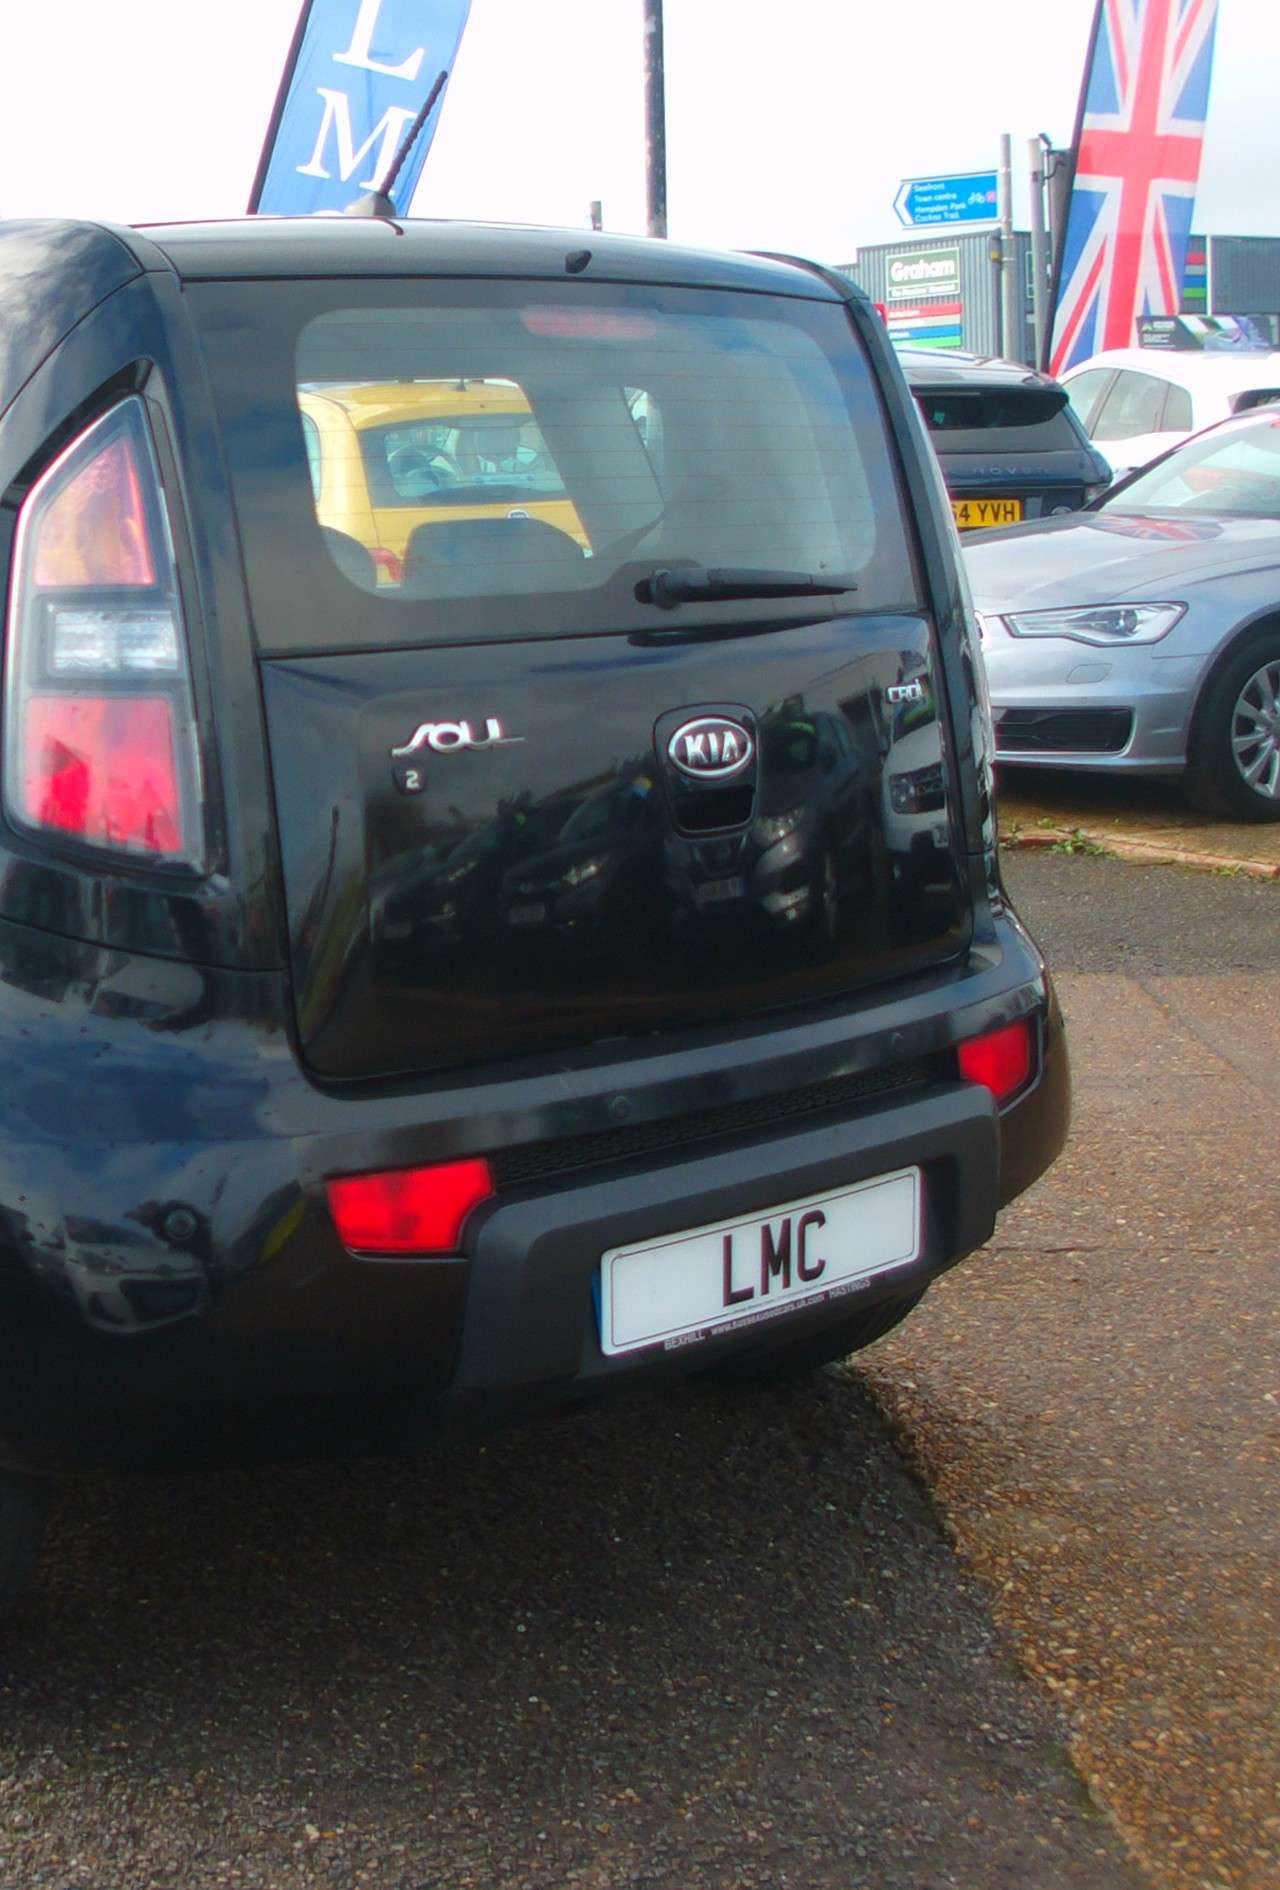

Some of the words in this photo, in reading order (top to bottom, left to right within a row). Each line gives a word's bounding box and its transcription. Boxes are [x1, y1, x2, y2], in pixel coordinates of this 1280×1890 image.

[296, 0, 426, 214] LM
[891, 259, 955, 282] Graham
[977, 503, 1015, 522] YVH
[685, 731, 739, 765] KIA
[406, 770, 419, 789] 2
[723, 1210, 826, 1307] LMC
